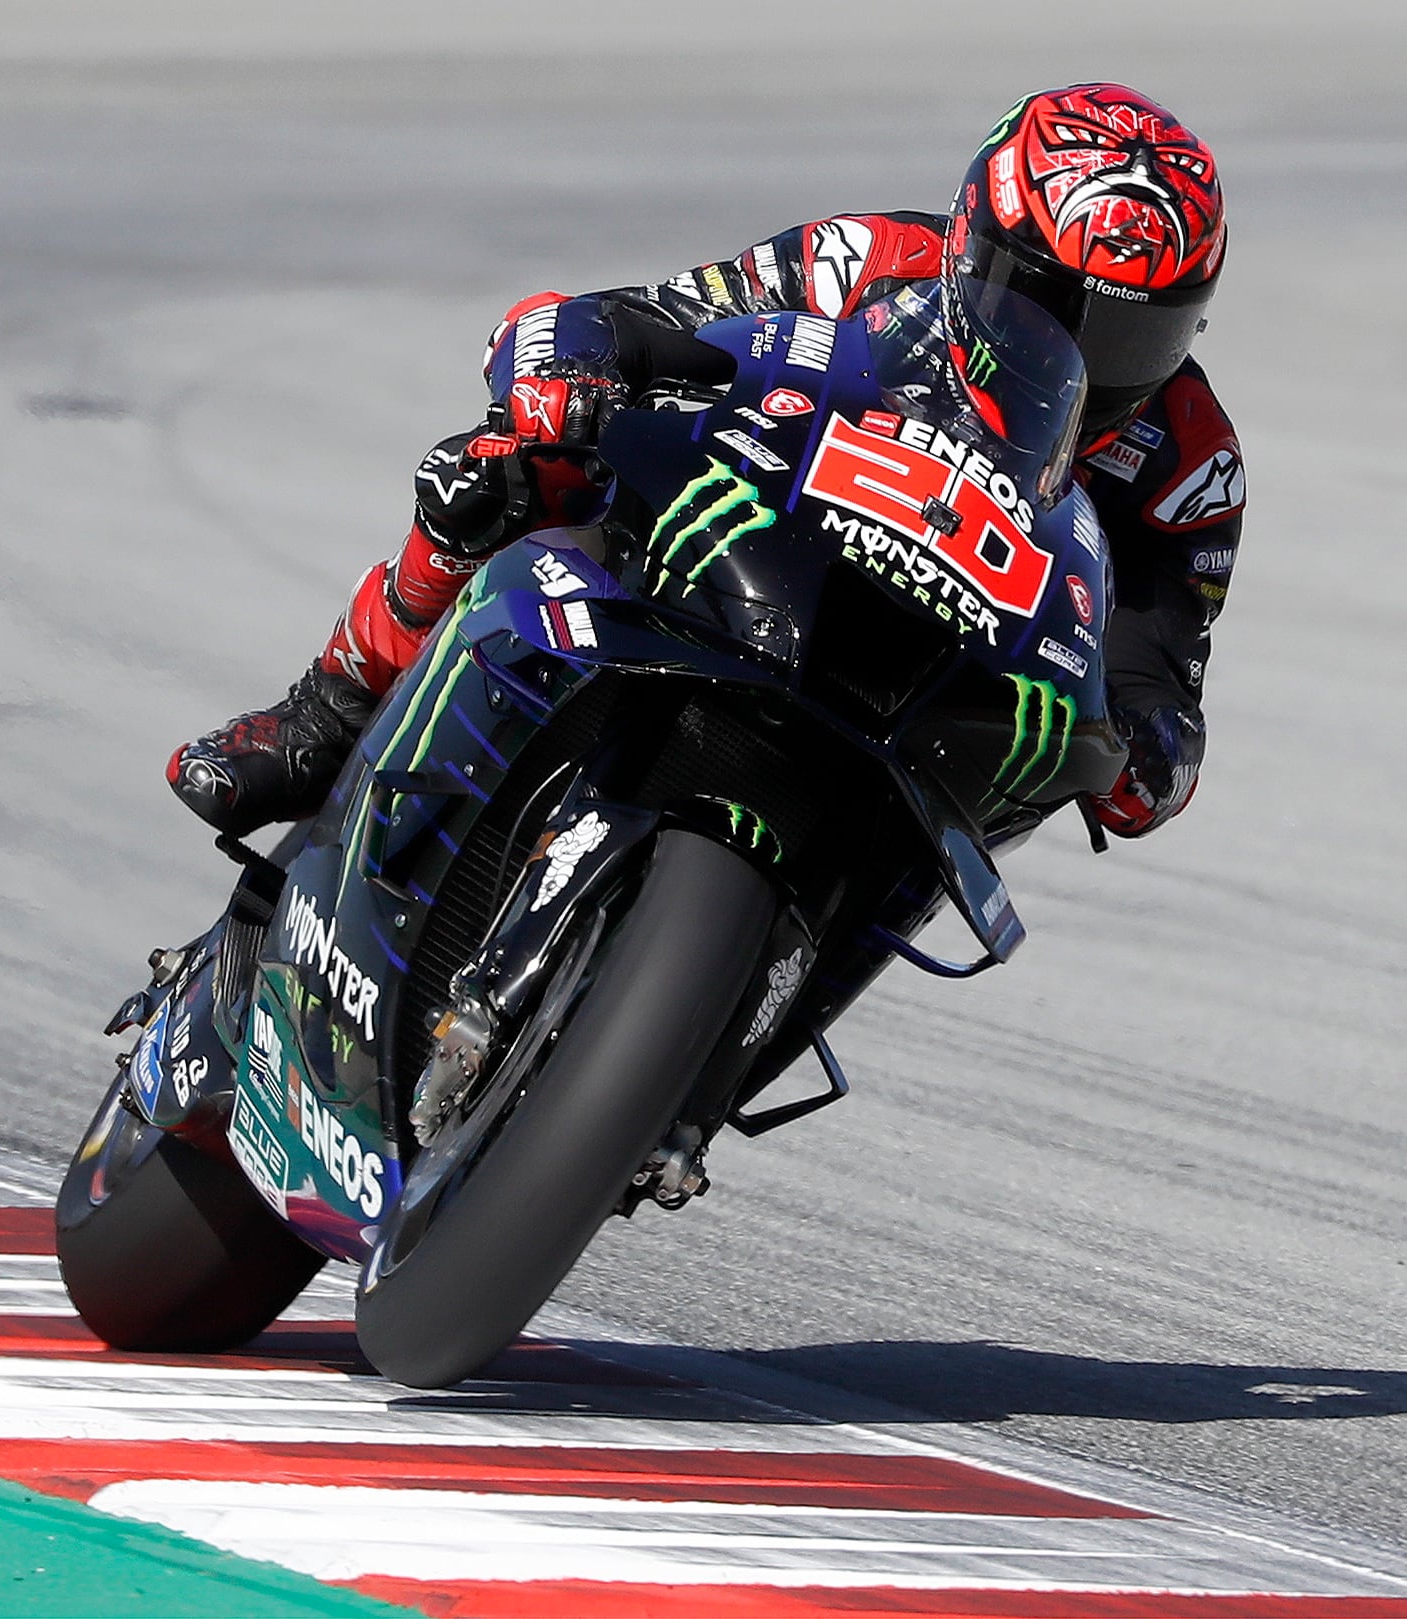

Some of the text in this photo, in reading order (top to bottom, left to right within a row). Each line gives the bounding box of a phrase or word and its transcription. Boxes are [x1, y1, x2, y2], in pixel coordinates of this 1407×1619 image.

[998, 146, 1020, 215] BS
[1096, 279, 1150, 302] fantom
[751, 333, 764, 360] FAST
[785, 314, 836, 373] YAMAHA
[802, 410, 1055, 619] 20
[899, 416, 1035, 534] ENEOS
[821, 509, 1000, 647] MONSTER
[842, 545, 973, 635] ENERGY
[237, 1099, 282, 1178] BLUE
[300, 1080, 384, 1219] ENEOS
